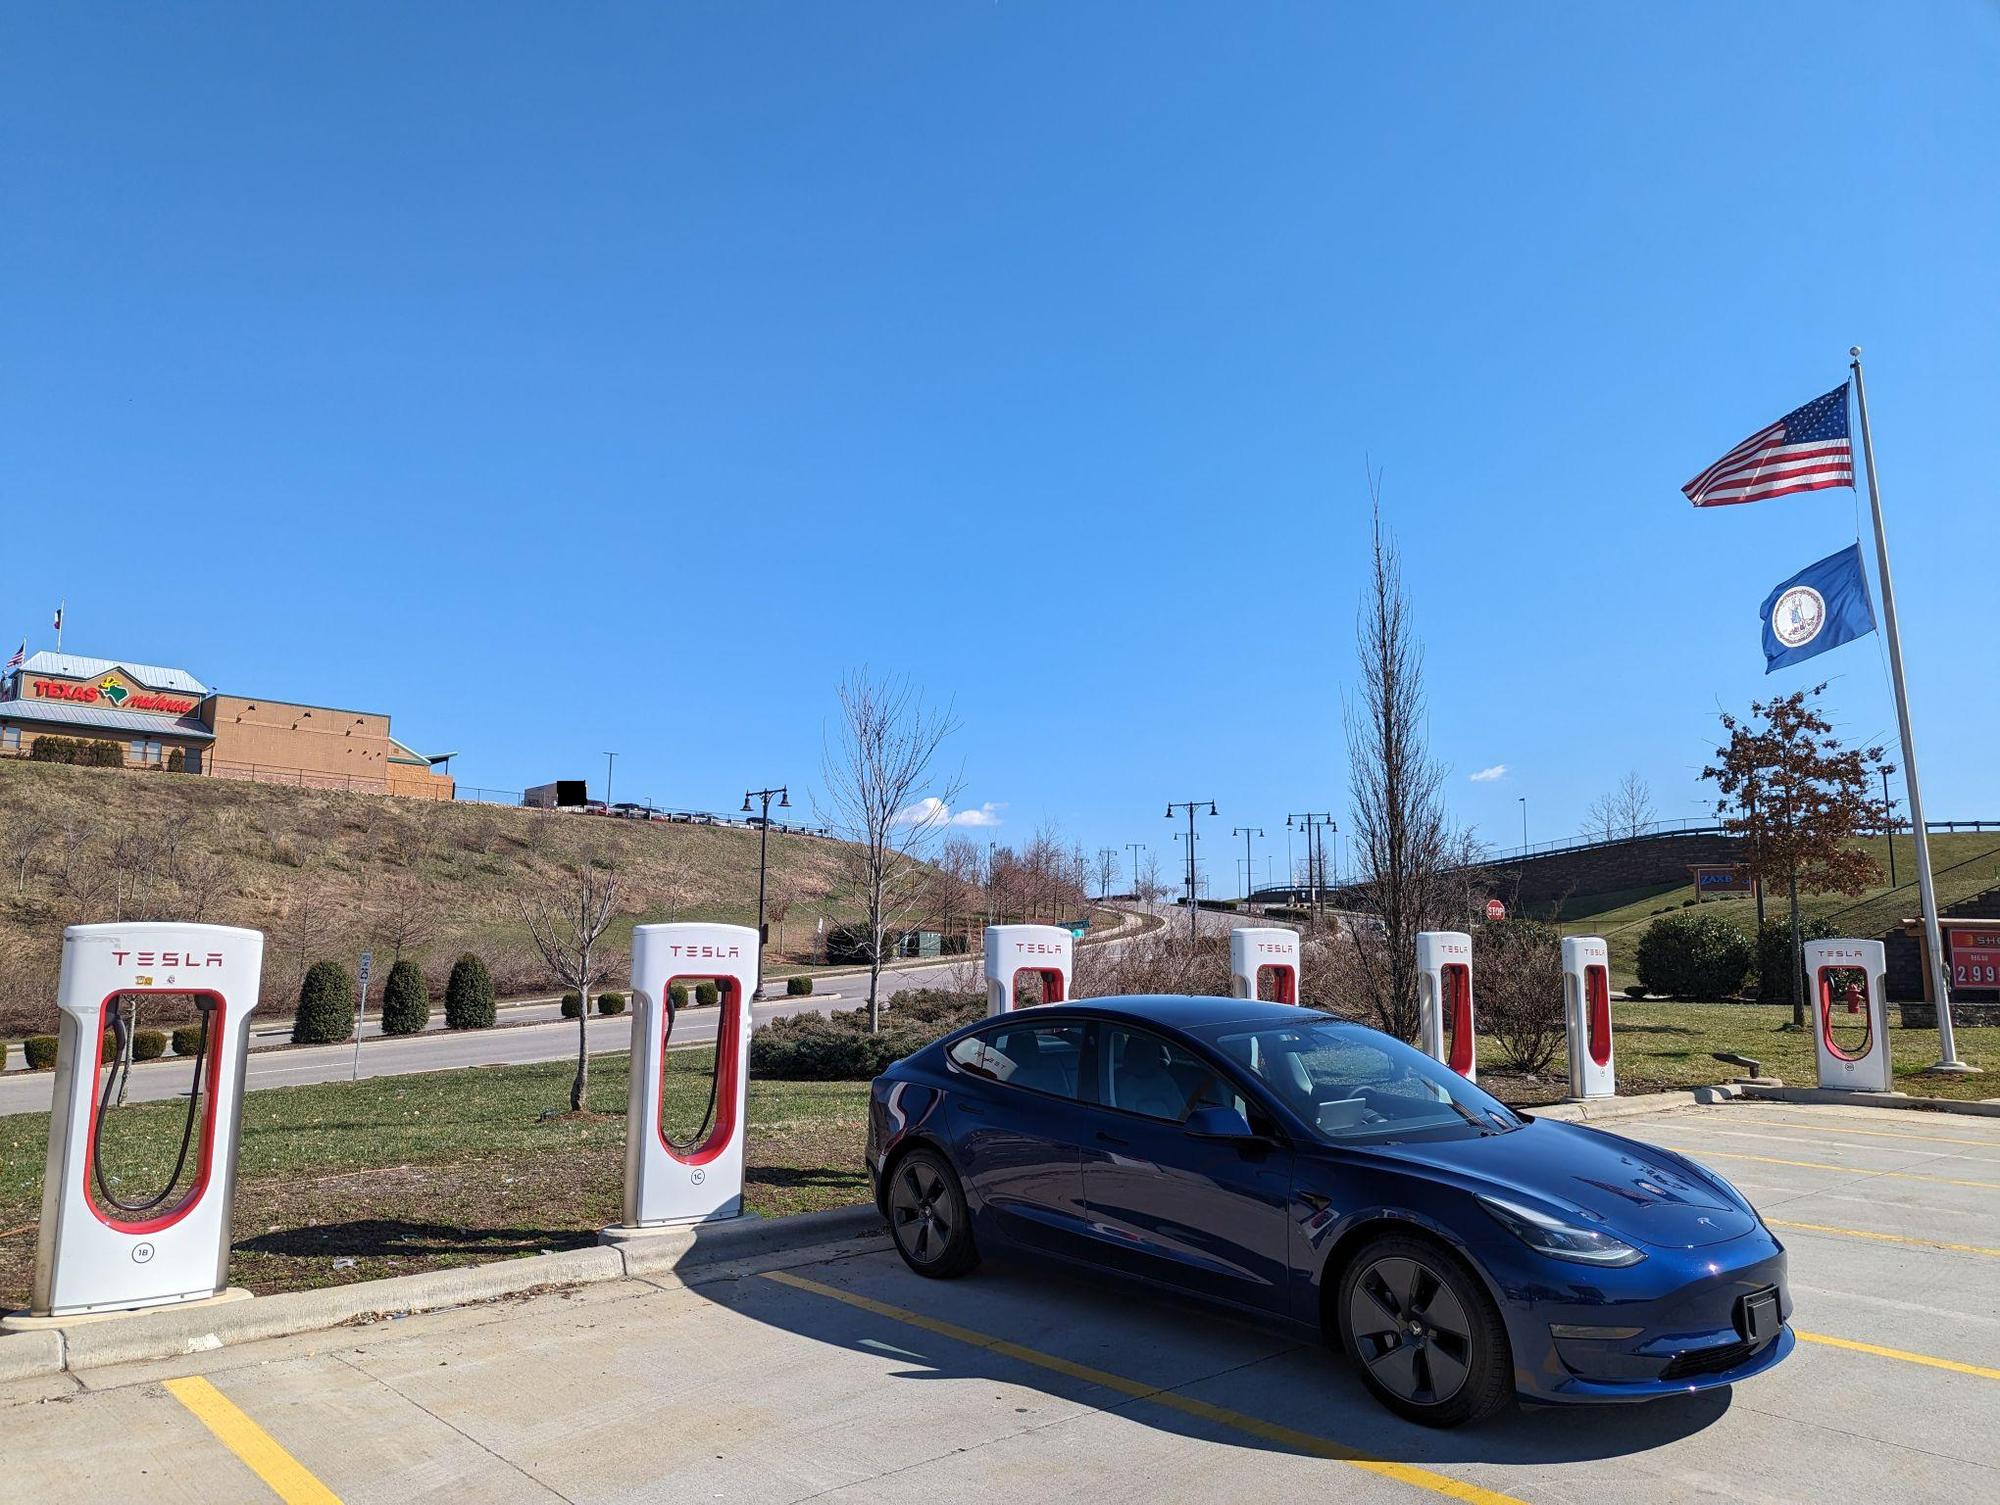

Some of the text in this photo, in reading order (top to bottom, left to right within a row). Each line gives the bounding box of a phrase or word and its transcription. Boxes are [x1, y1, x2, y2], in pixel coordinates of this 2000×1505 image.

[33, 681, 99, 703] TEXAS
[1488, 906, 1505, 916] STOP
[669, 945, 739, 958] TESLA
[1016, 943, 1062, 954] TESLA
[1257, 943, 1293, 953] TESLA
[1441, 945, 1468, 954] TESLA
[111, 951, 223, 967] TESLA
[1817, 950, 1863, 958] TESLA
